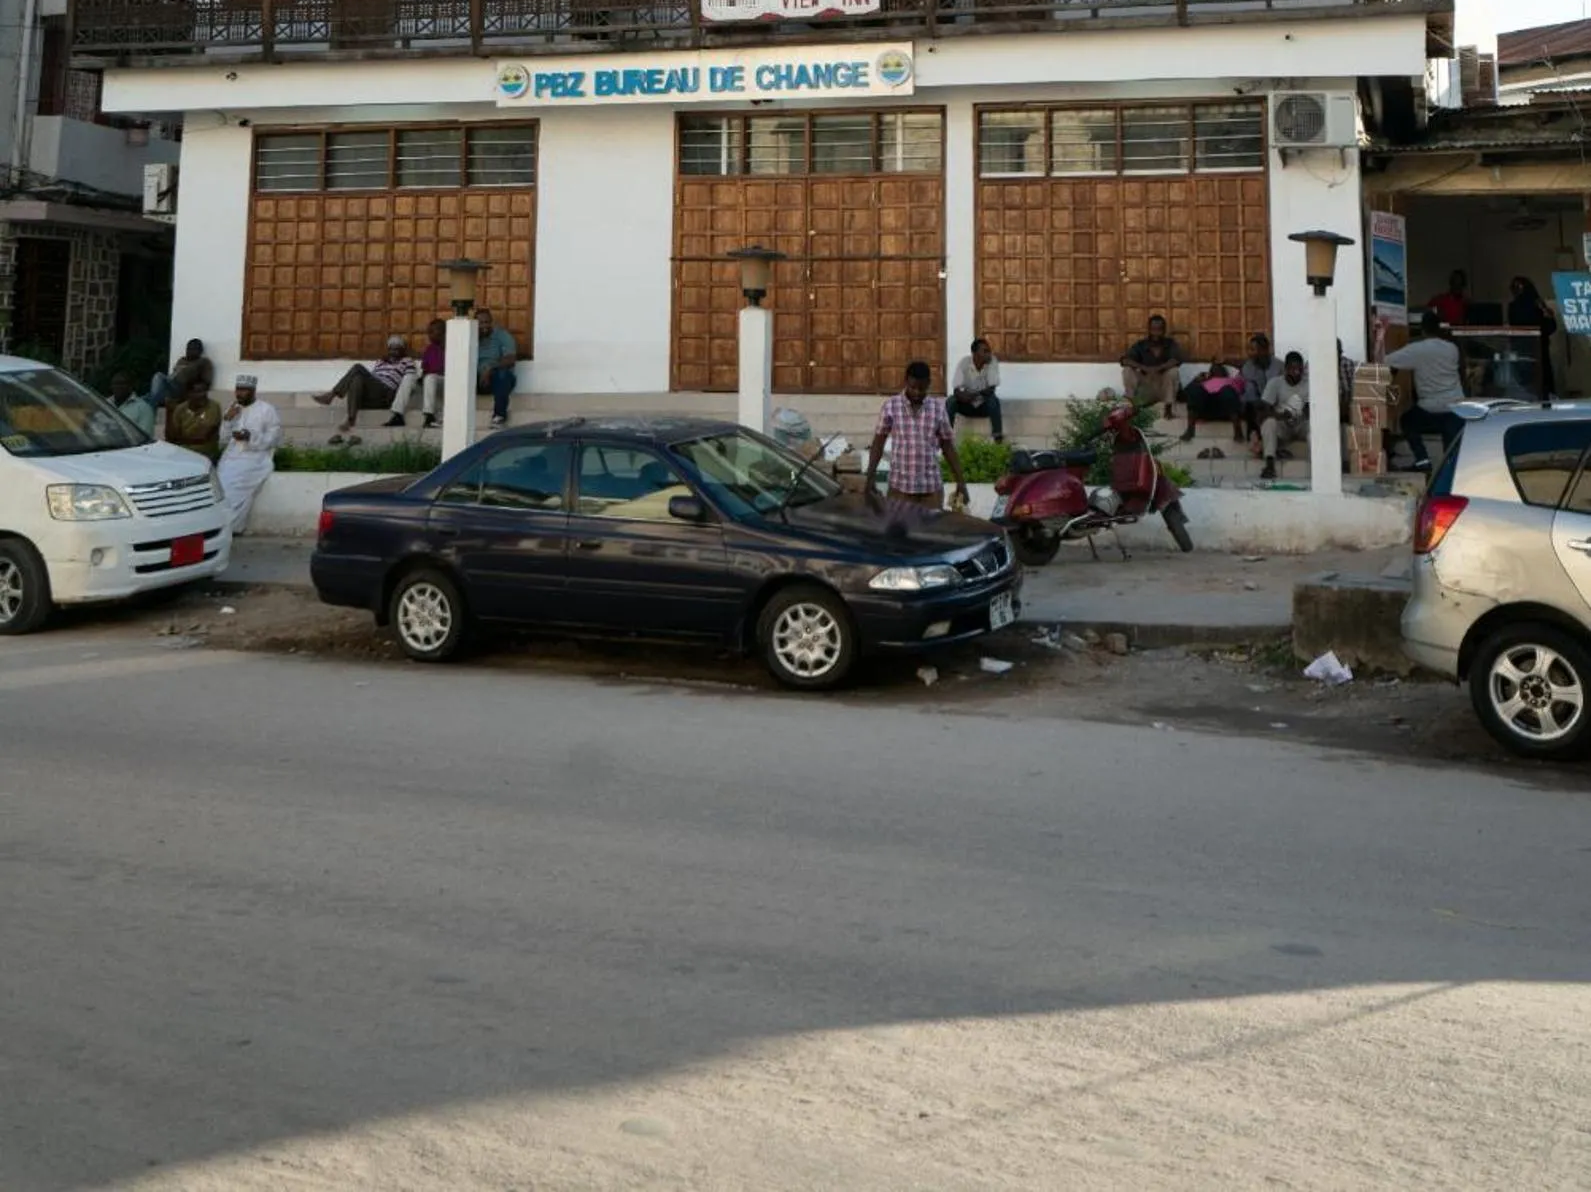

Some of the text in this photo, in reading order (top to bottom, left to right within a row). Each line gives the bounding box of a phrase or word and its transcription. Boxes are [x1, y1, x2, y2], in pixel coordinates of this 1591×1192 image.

[534, 61, 871, 99] PBZ BUREAU DE CHANGE
[1563, 298, 1591, 314] ST
